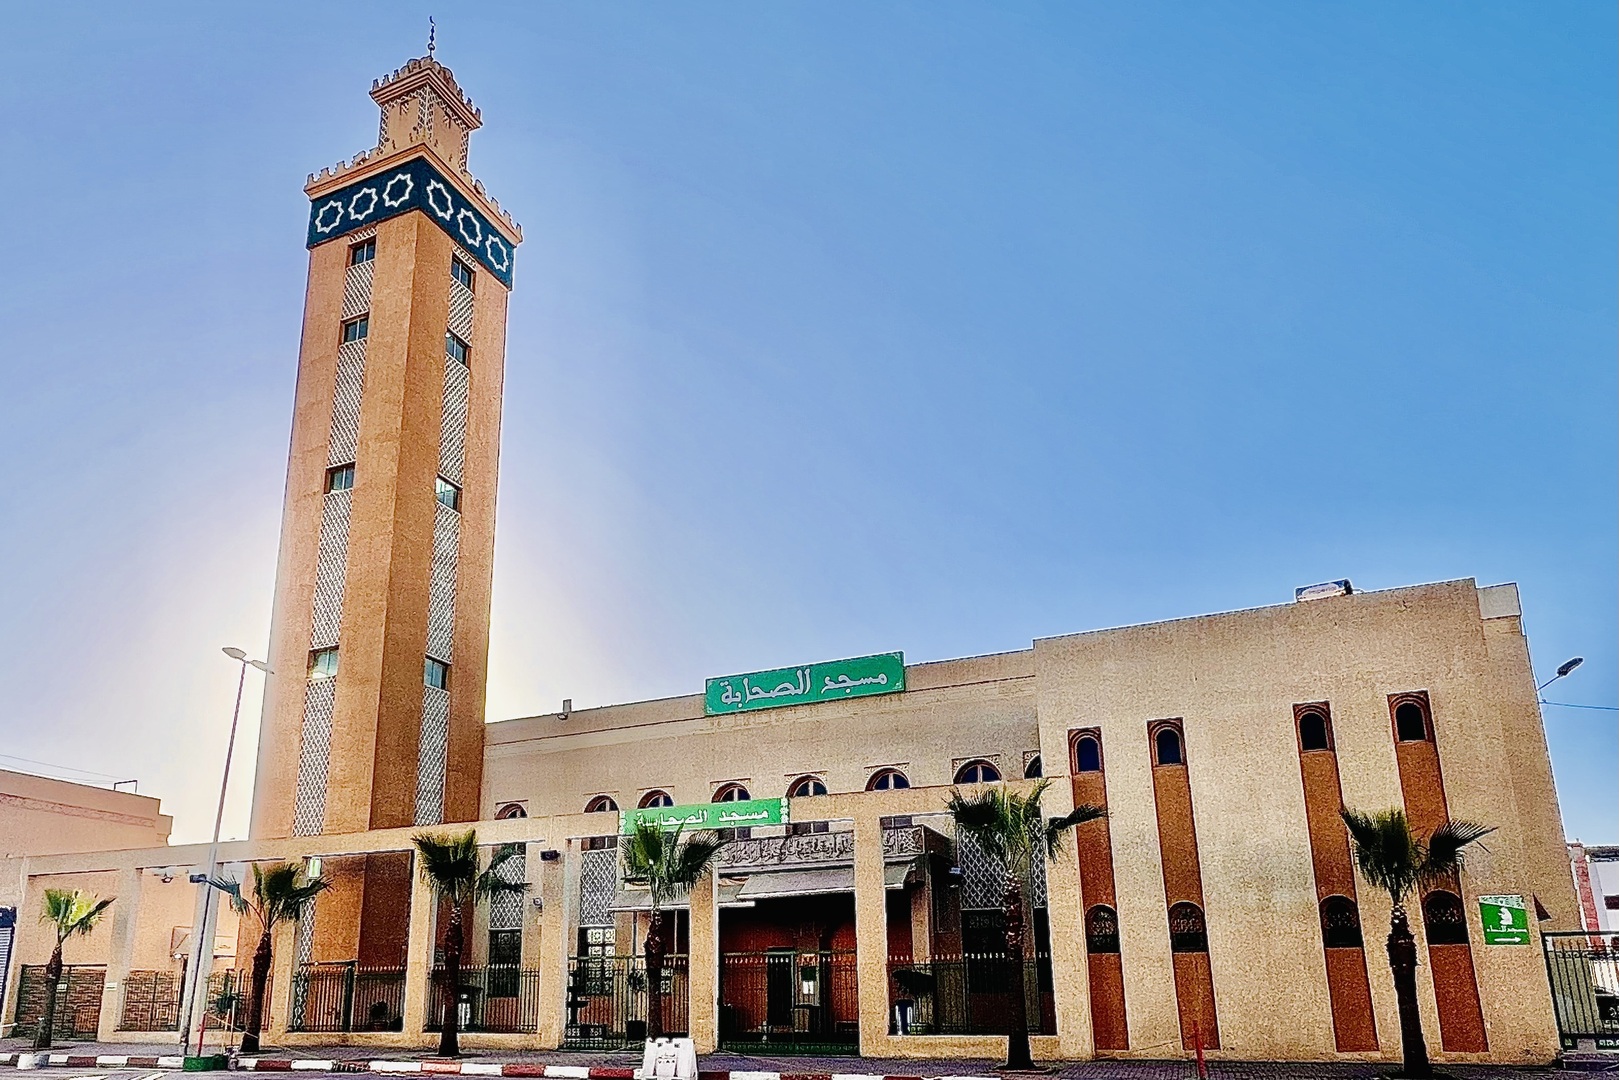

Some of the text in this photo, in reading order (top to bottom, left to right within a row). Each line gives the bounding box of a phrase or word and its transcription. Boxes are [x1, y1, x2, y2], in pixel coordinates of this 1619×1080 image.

[720, 667, 888, 708] مسجد الصحابة
[718, 808, 769, 826] مسجد
